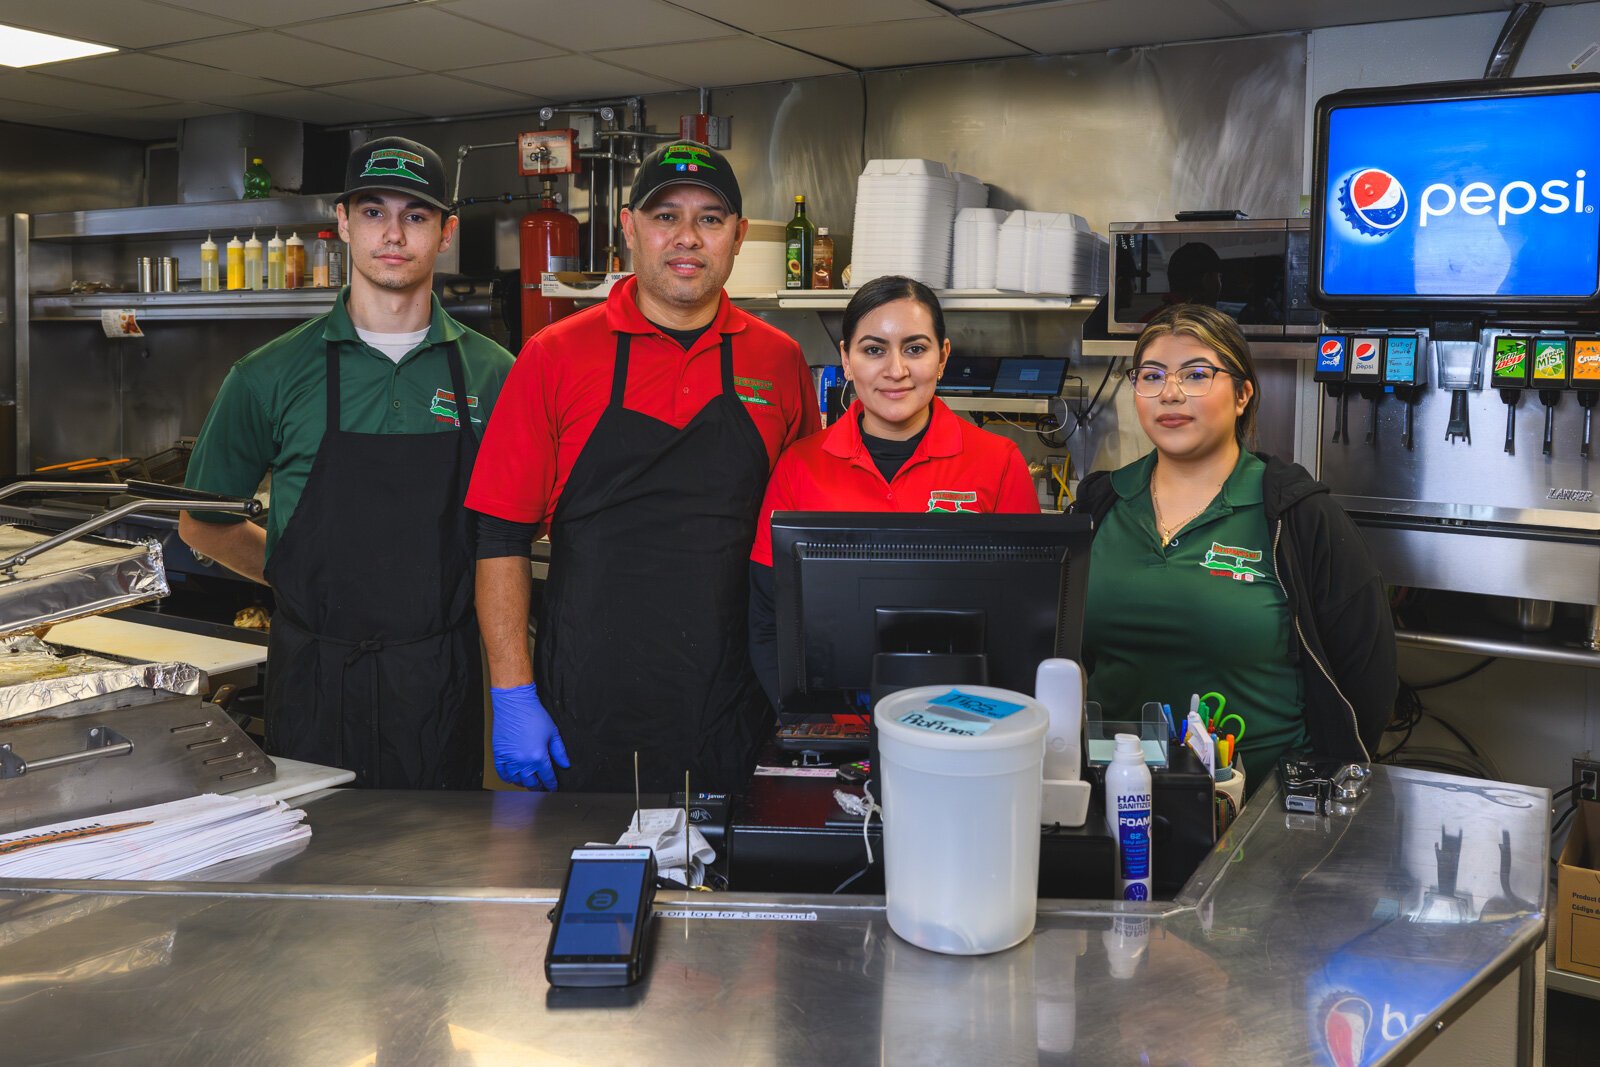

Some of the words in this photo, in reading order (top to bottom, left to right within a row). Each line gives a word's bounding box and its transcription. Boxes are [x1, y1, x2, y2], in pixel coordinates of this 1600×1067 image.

[1419, 169, 1586, 227] pepsi
[1537, 350, 1565, 368] MIST
[1120, 816, 1150, 827] FOAM
[1572, 892, 1596, 902] Product
[754, 912, 816, 920] seconds
